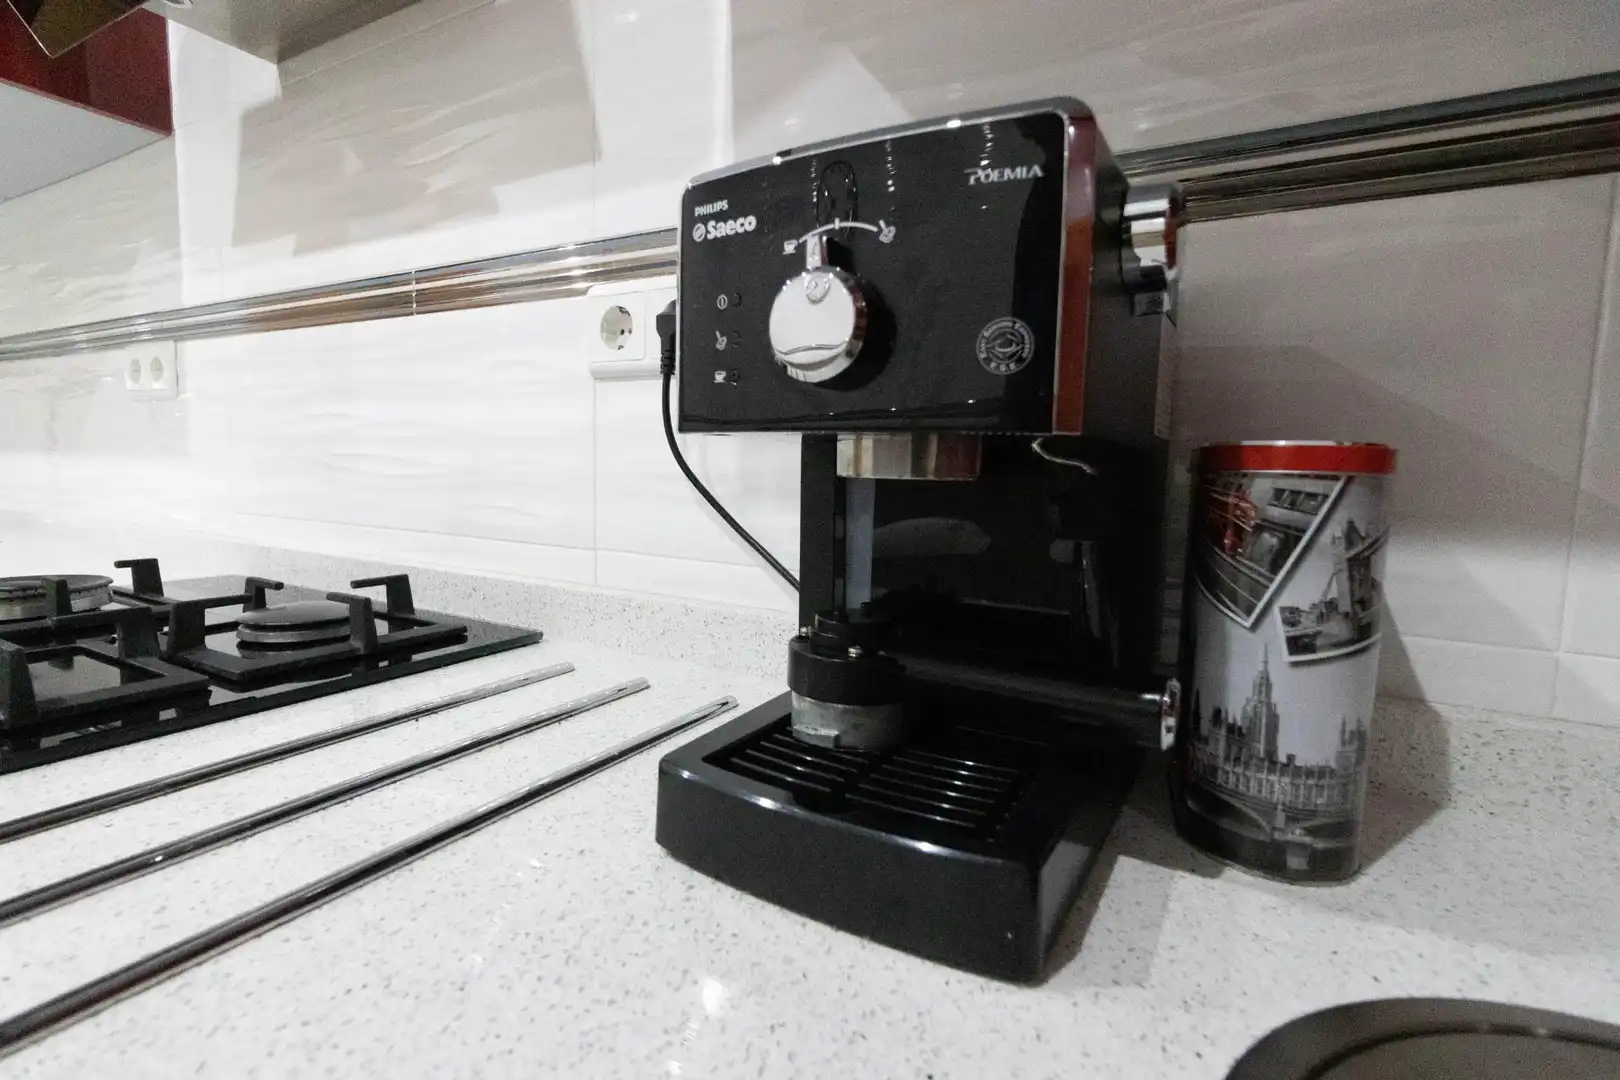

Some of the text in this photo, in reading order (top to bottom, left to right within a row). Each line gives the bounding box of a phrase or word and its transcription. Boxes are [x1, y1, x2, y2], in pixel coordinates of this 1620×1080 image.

[963, 164, 1043, 186] POEMIA
[695, 200, 728, 217] PHILIPS
[706, 215, 757, 240] Saeco
